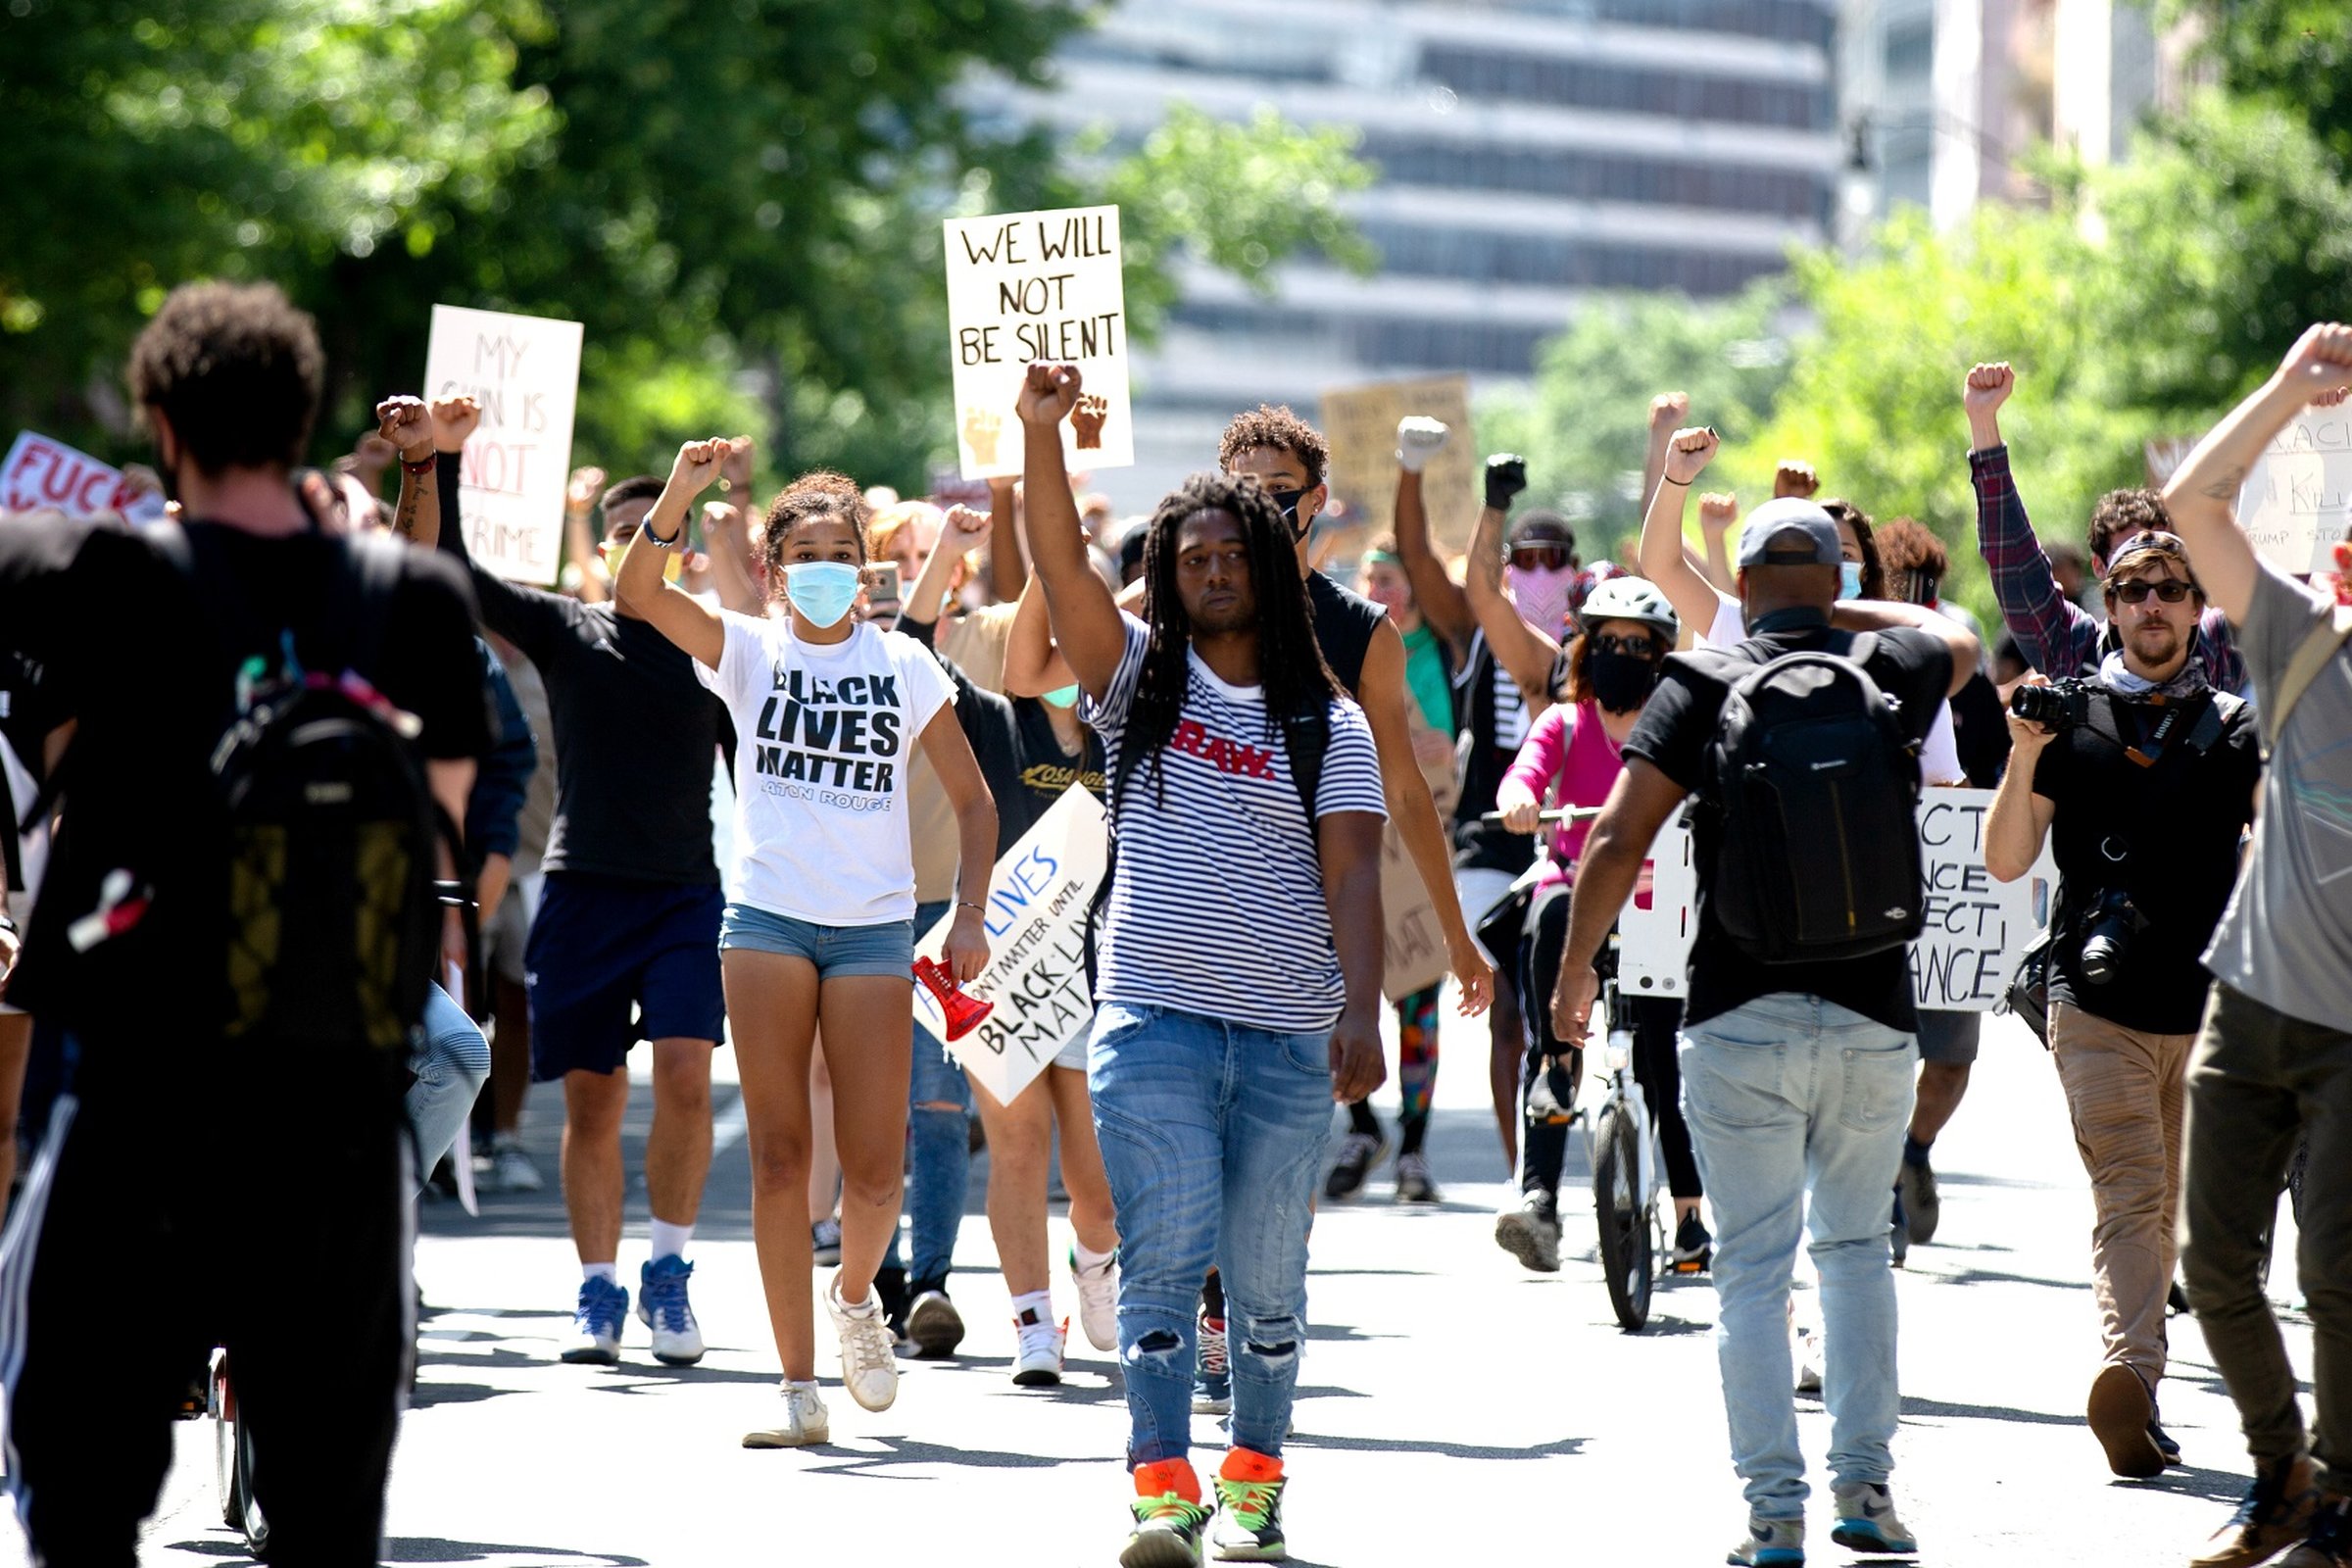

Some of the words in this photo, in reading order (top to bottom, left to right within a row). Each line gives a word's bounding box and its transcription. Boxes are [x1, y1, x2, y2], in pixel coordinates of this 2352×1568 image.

[960, 221, 1027, 265] WE
[1039, 216, 1111, 262] WILL
[1000, 273, 1075, 315] NOT
[474, 332, 529, 379] MY
[959, 325, 1003, 365] BE
[1016, 313, 1119, 364] SILENT
[522, 392, 548, 433] IS
[2274, 421, 2351, 449] ACI
[10, 442, 144, 525] FUCK
[460, 441, 538, 494] NOT
[462, 512, 543, 566] RIME
[756, 696, 901, 758] LIVES
[756, 743, 894, 793] MATTER
[761, 780, 814, 801] ATON
[819, 790, 893, 812] ROUGE
[1917, 801, 1987, 854] CT
[983, 843, 1058, 938] LIVES
[999, 917, 1052, 975] MATTER
[1048, 880, 1085, 917] UNTIL
[978, 956, 1065, 1056] BLACK
[1052, 894, 1106, 964] LIVE
[1017, 968, 1089, 1064] MAT
